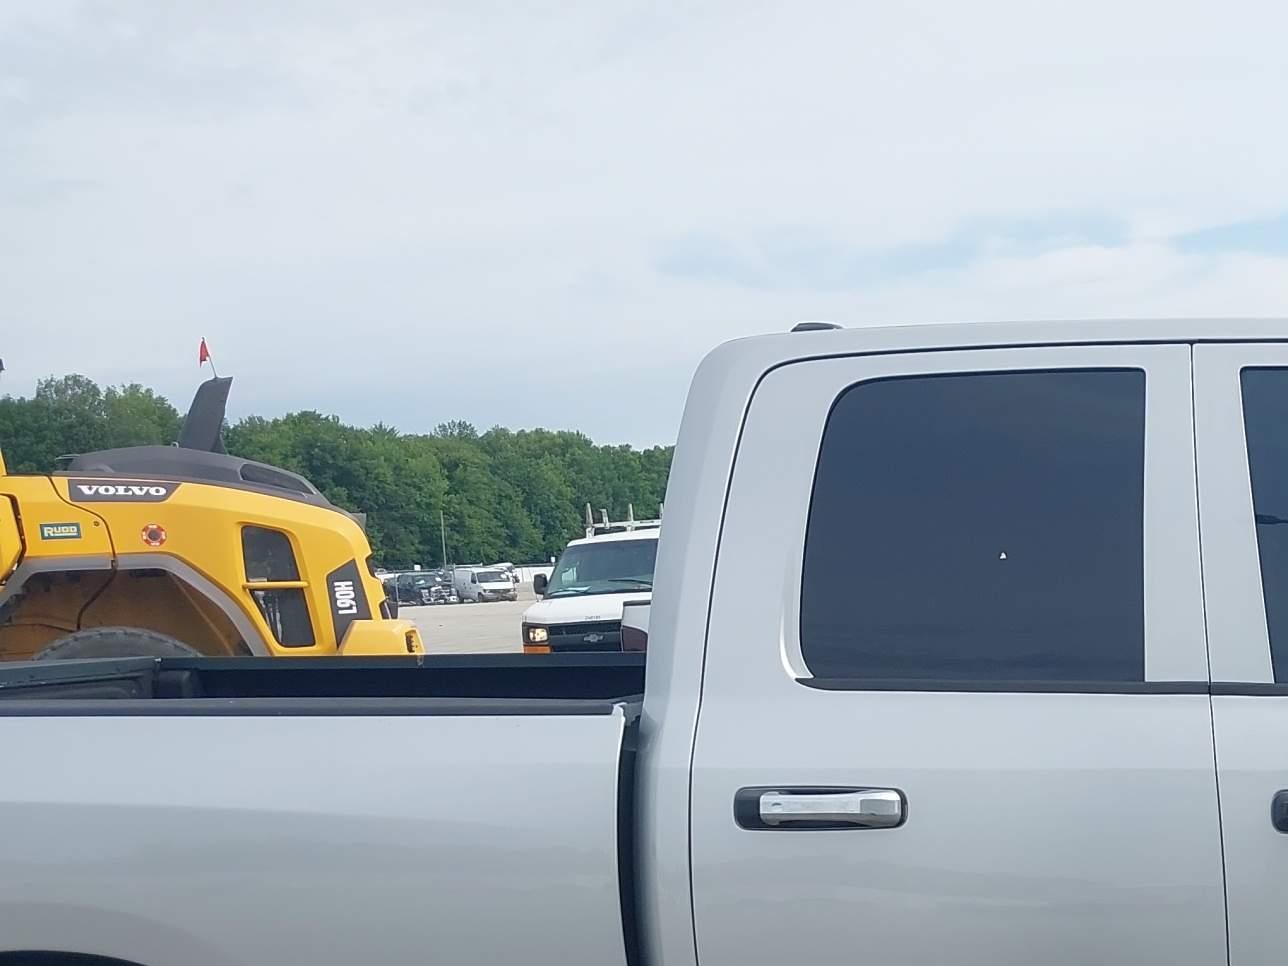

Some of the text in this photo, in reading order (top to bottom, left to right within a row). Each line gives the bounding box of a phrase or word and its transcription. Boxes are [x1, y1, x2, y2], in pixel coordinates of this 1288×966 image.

[77, 485, 166, 497] VOLVO
[44, 526, 78, 537] RUDD
[333, 581, 358, 615] L90H
